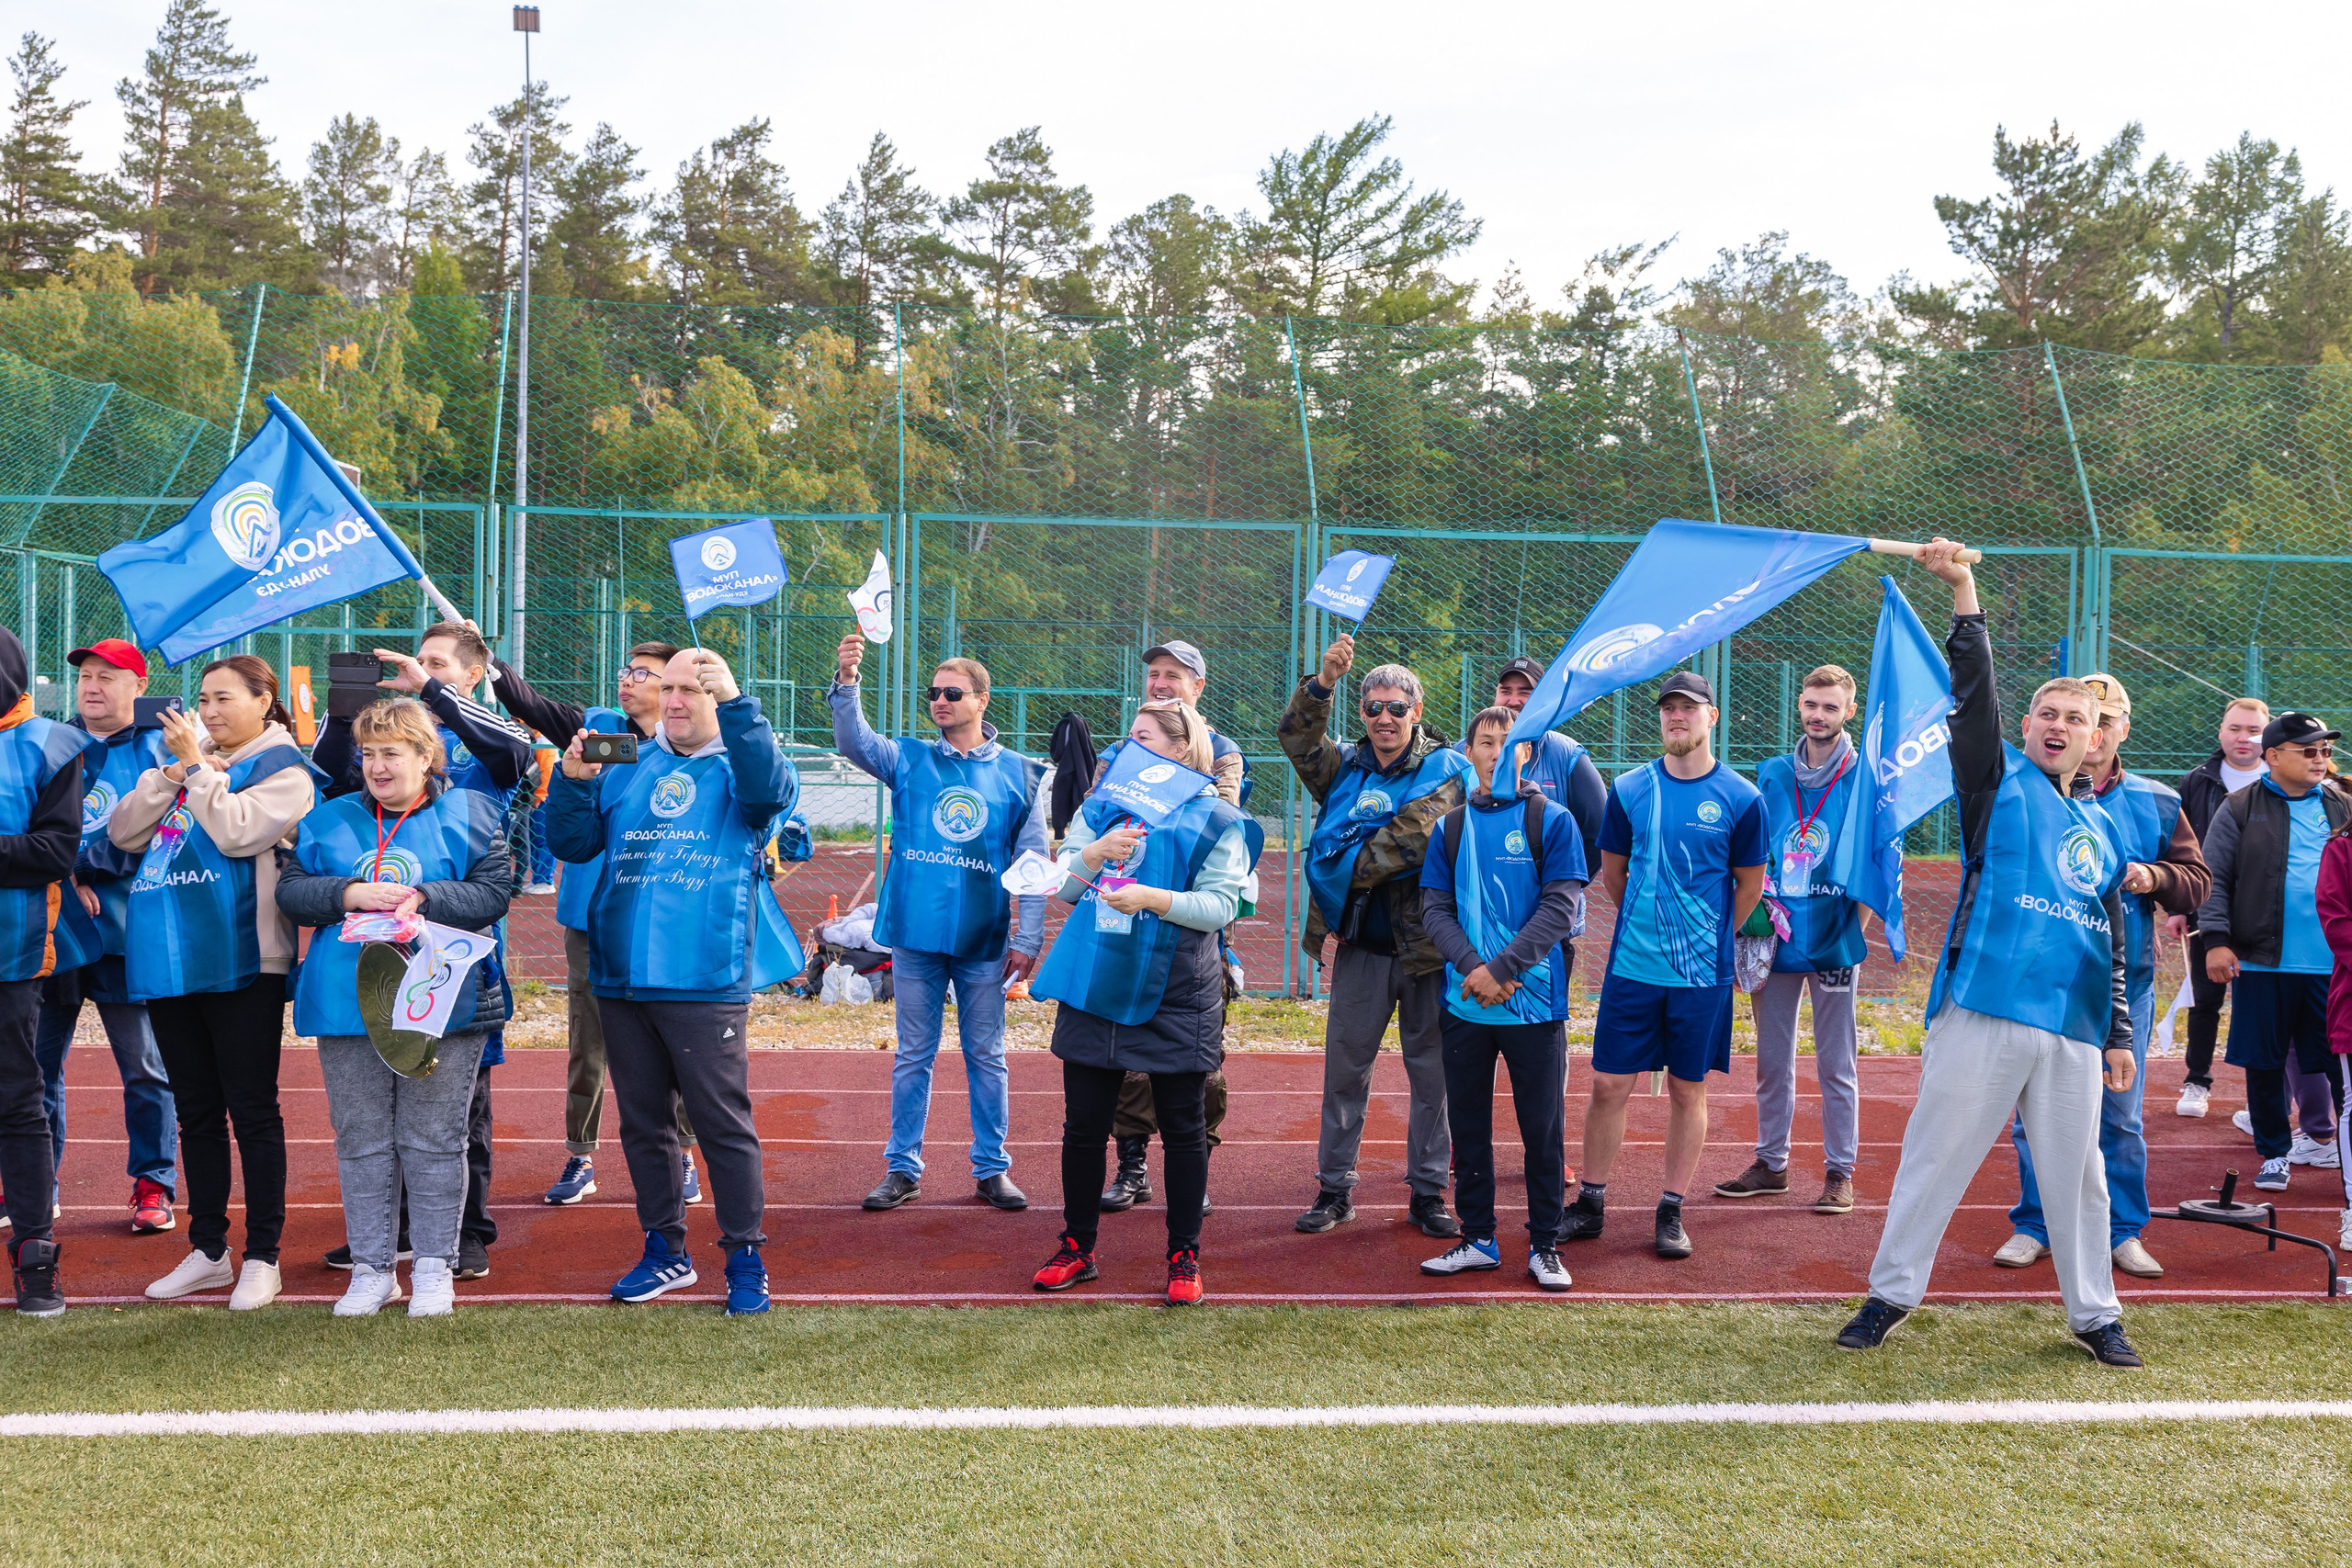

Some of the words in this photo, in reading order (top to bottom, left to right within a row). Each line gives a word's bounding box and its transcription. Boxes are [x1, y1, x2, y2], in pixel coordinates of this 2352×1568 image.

[712, 570, 741, 585] МУП
[620, 829, 711, 841] «ВОДОКАНАЛ»
[670, 844, 721, 869] Городу
[943, 845, 962, 854] МУП
[901, 849, 998, 874] «ВОДОКАНАЛ»
[664, 868, 713, 892] Воду!
[2068, 897, 2088, 911] МУП
[2014, 894, 2112, 936] «ВОДОКАНА
